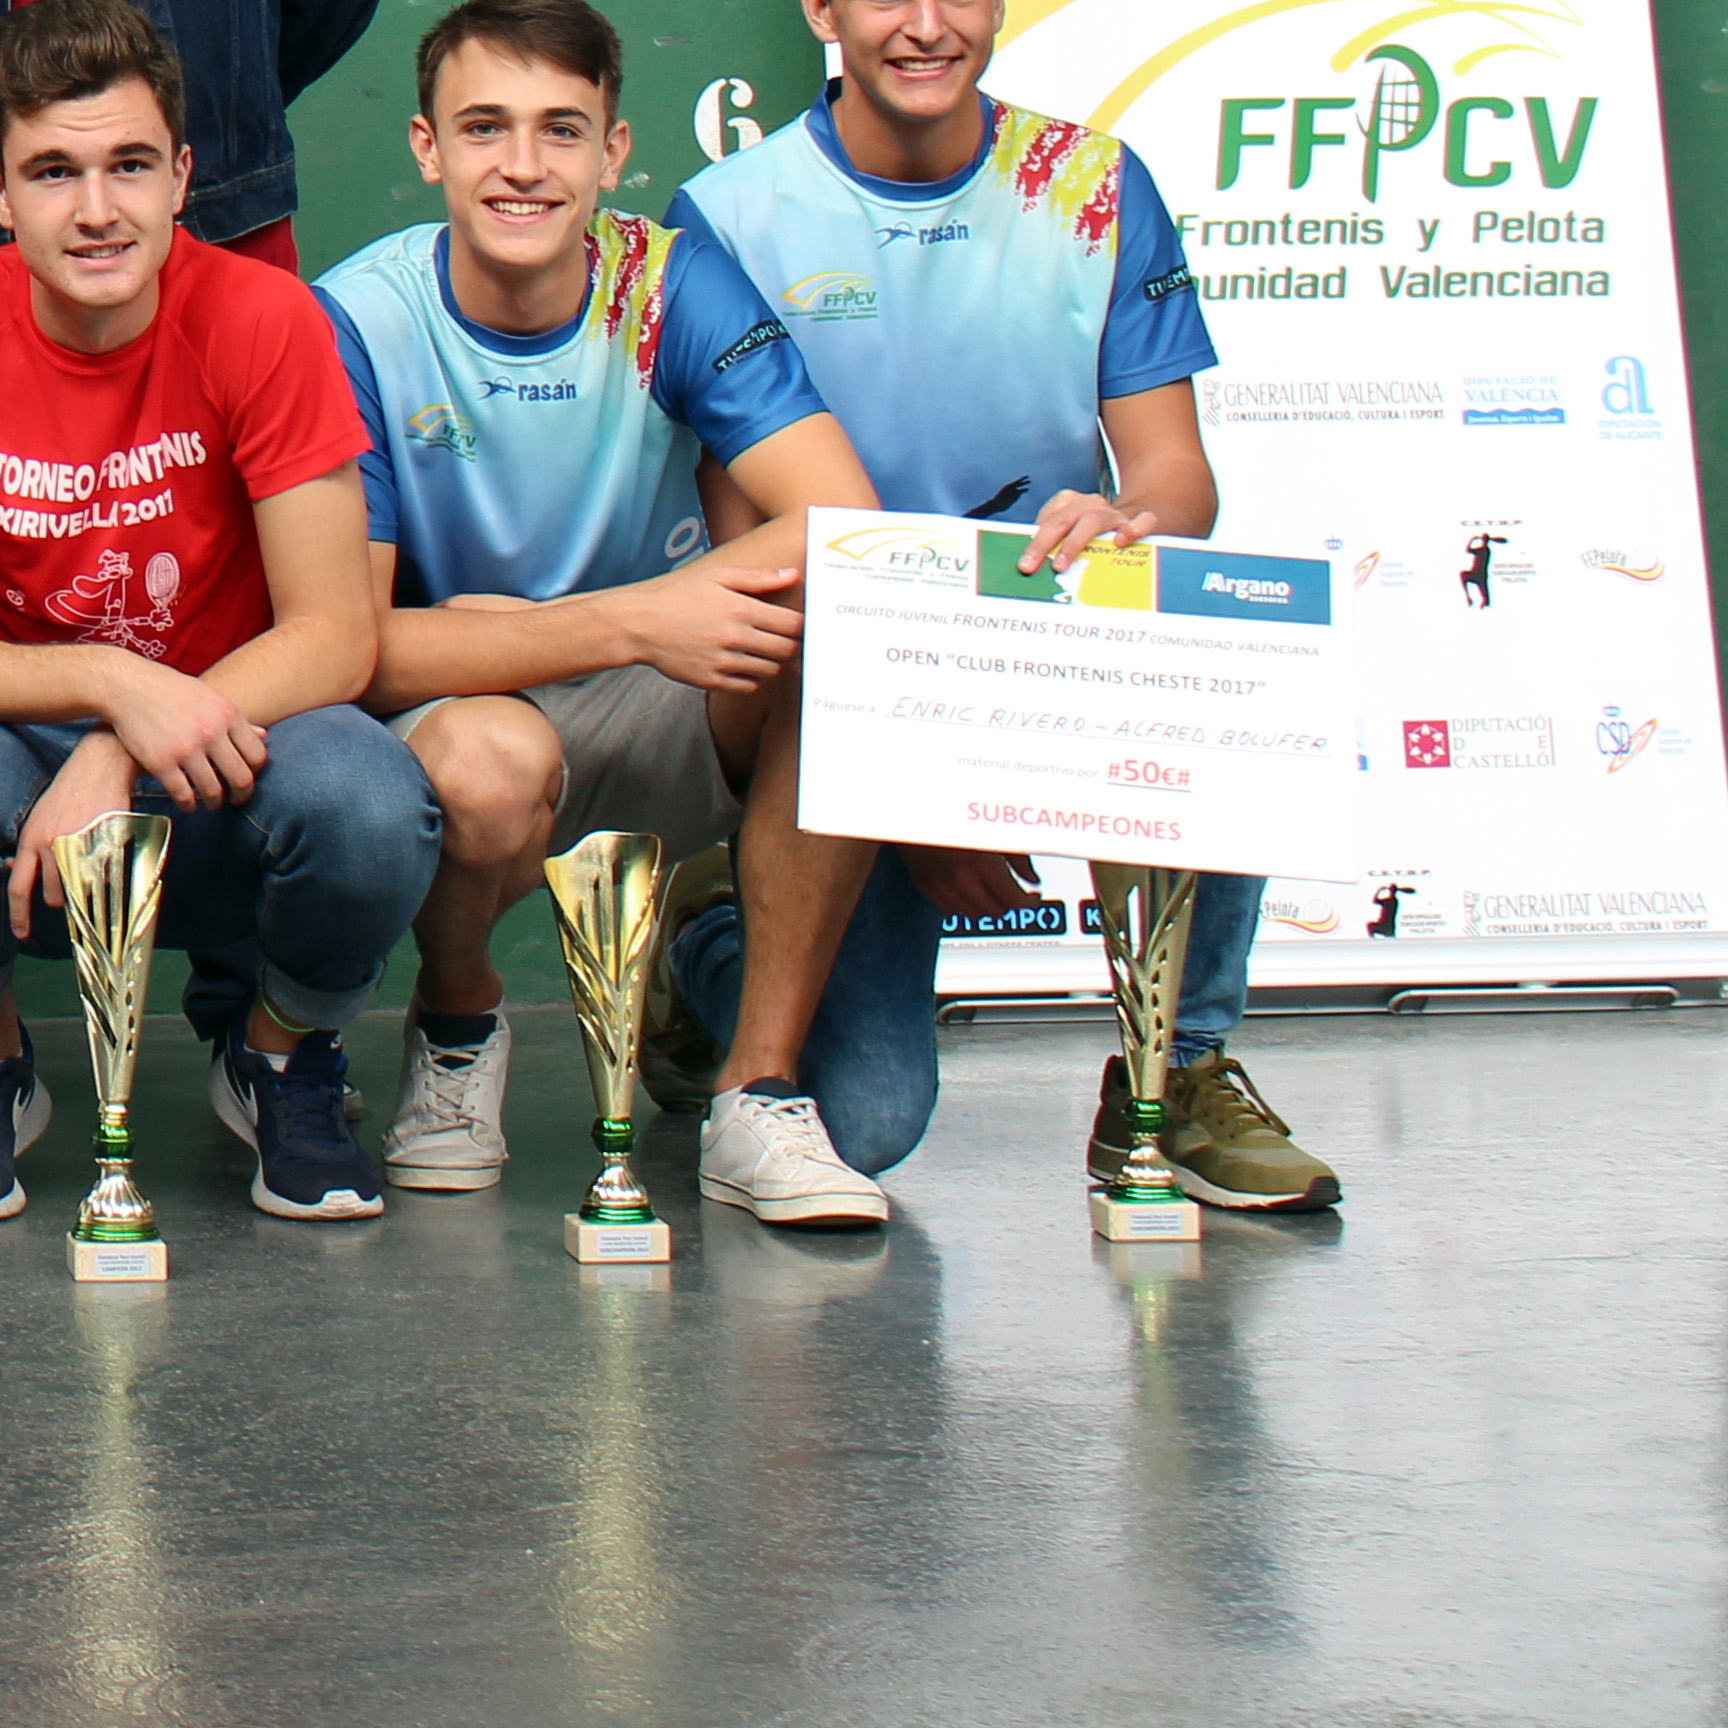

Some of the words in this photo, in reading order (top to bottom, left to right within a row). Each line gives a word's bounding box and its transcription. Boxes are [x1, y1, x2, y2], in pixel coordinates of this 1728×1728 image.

[694, 78, 762, 162] 6
[1215, 44, 1599, 204] FFPCV
[918, 218, 969, 246] rasán
[1175, 213, 1384, 247] Frontenis
[1417, 218, 1441, 252] y
[1472, 210, 1604, 244] Pelota
[823, 286, 877, 307] FFPCV
[1192, 266, 1346, 300] unidad
[1380, 264, 1610, 299] Valenciana
[517, 378, 577, 402] rasán
[1224, 381, 1329, 407] GENERALITAT
[1337, 380, 1443, 405] VALENCIANA
[121, 488, 175, 526] 2017
[888, 546, 972, 573] FFPCV
[1201, 571, 1291, 602] Argano
[952, 612, 1048, 634] FRONTENIS
[1053, 622, 1100, 639] TOUR
[1104, 628, 1146, 643] 2017
[1149, 634, 1234, 651] COMUNIDAD
[1237, 641, 1320, 657] VALENCIANA
[886, 647, 940, 667] OPEN
[1013, 660, 1123, 685] FRONTENIS
[1130, 672, 1203, 692] CHESTE
[890, 696, 975, 723] ENRIC
[987, 708, 1087, 732] RIVERO
[1112, 719, 1206, 744] ALFRED
[1218, 729, 1329, 753] BOLUFER
[958, 755, 1011, 770] material
[1013, 760, 1074, 778] deportivo
[967, 800, 1182, 842] SUBCAMPEONES
[1484, 893, 1591, 919] GENERALITAT
[1597, 891, 1708, 915] VALENCIANA
